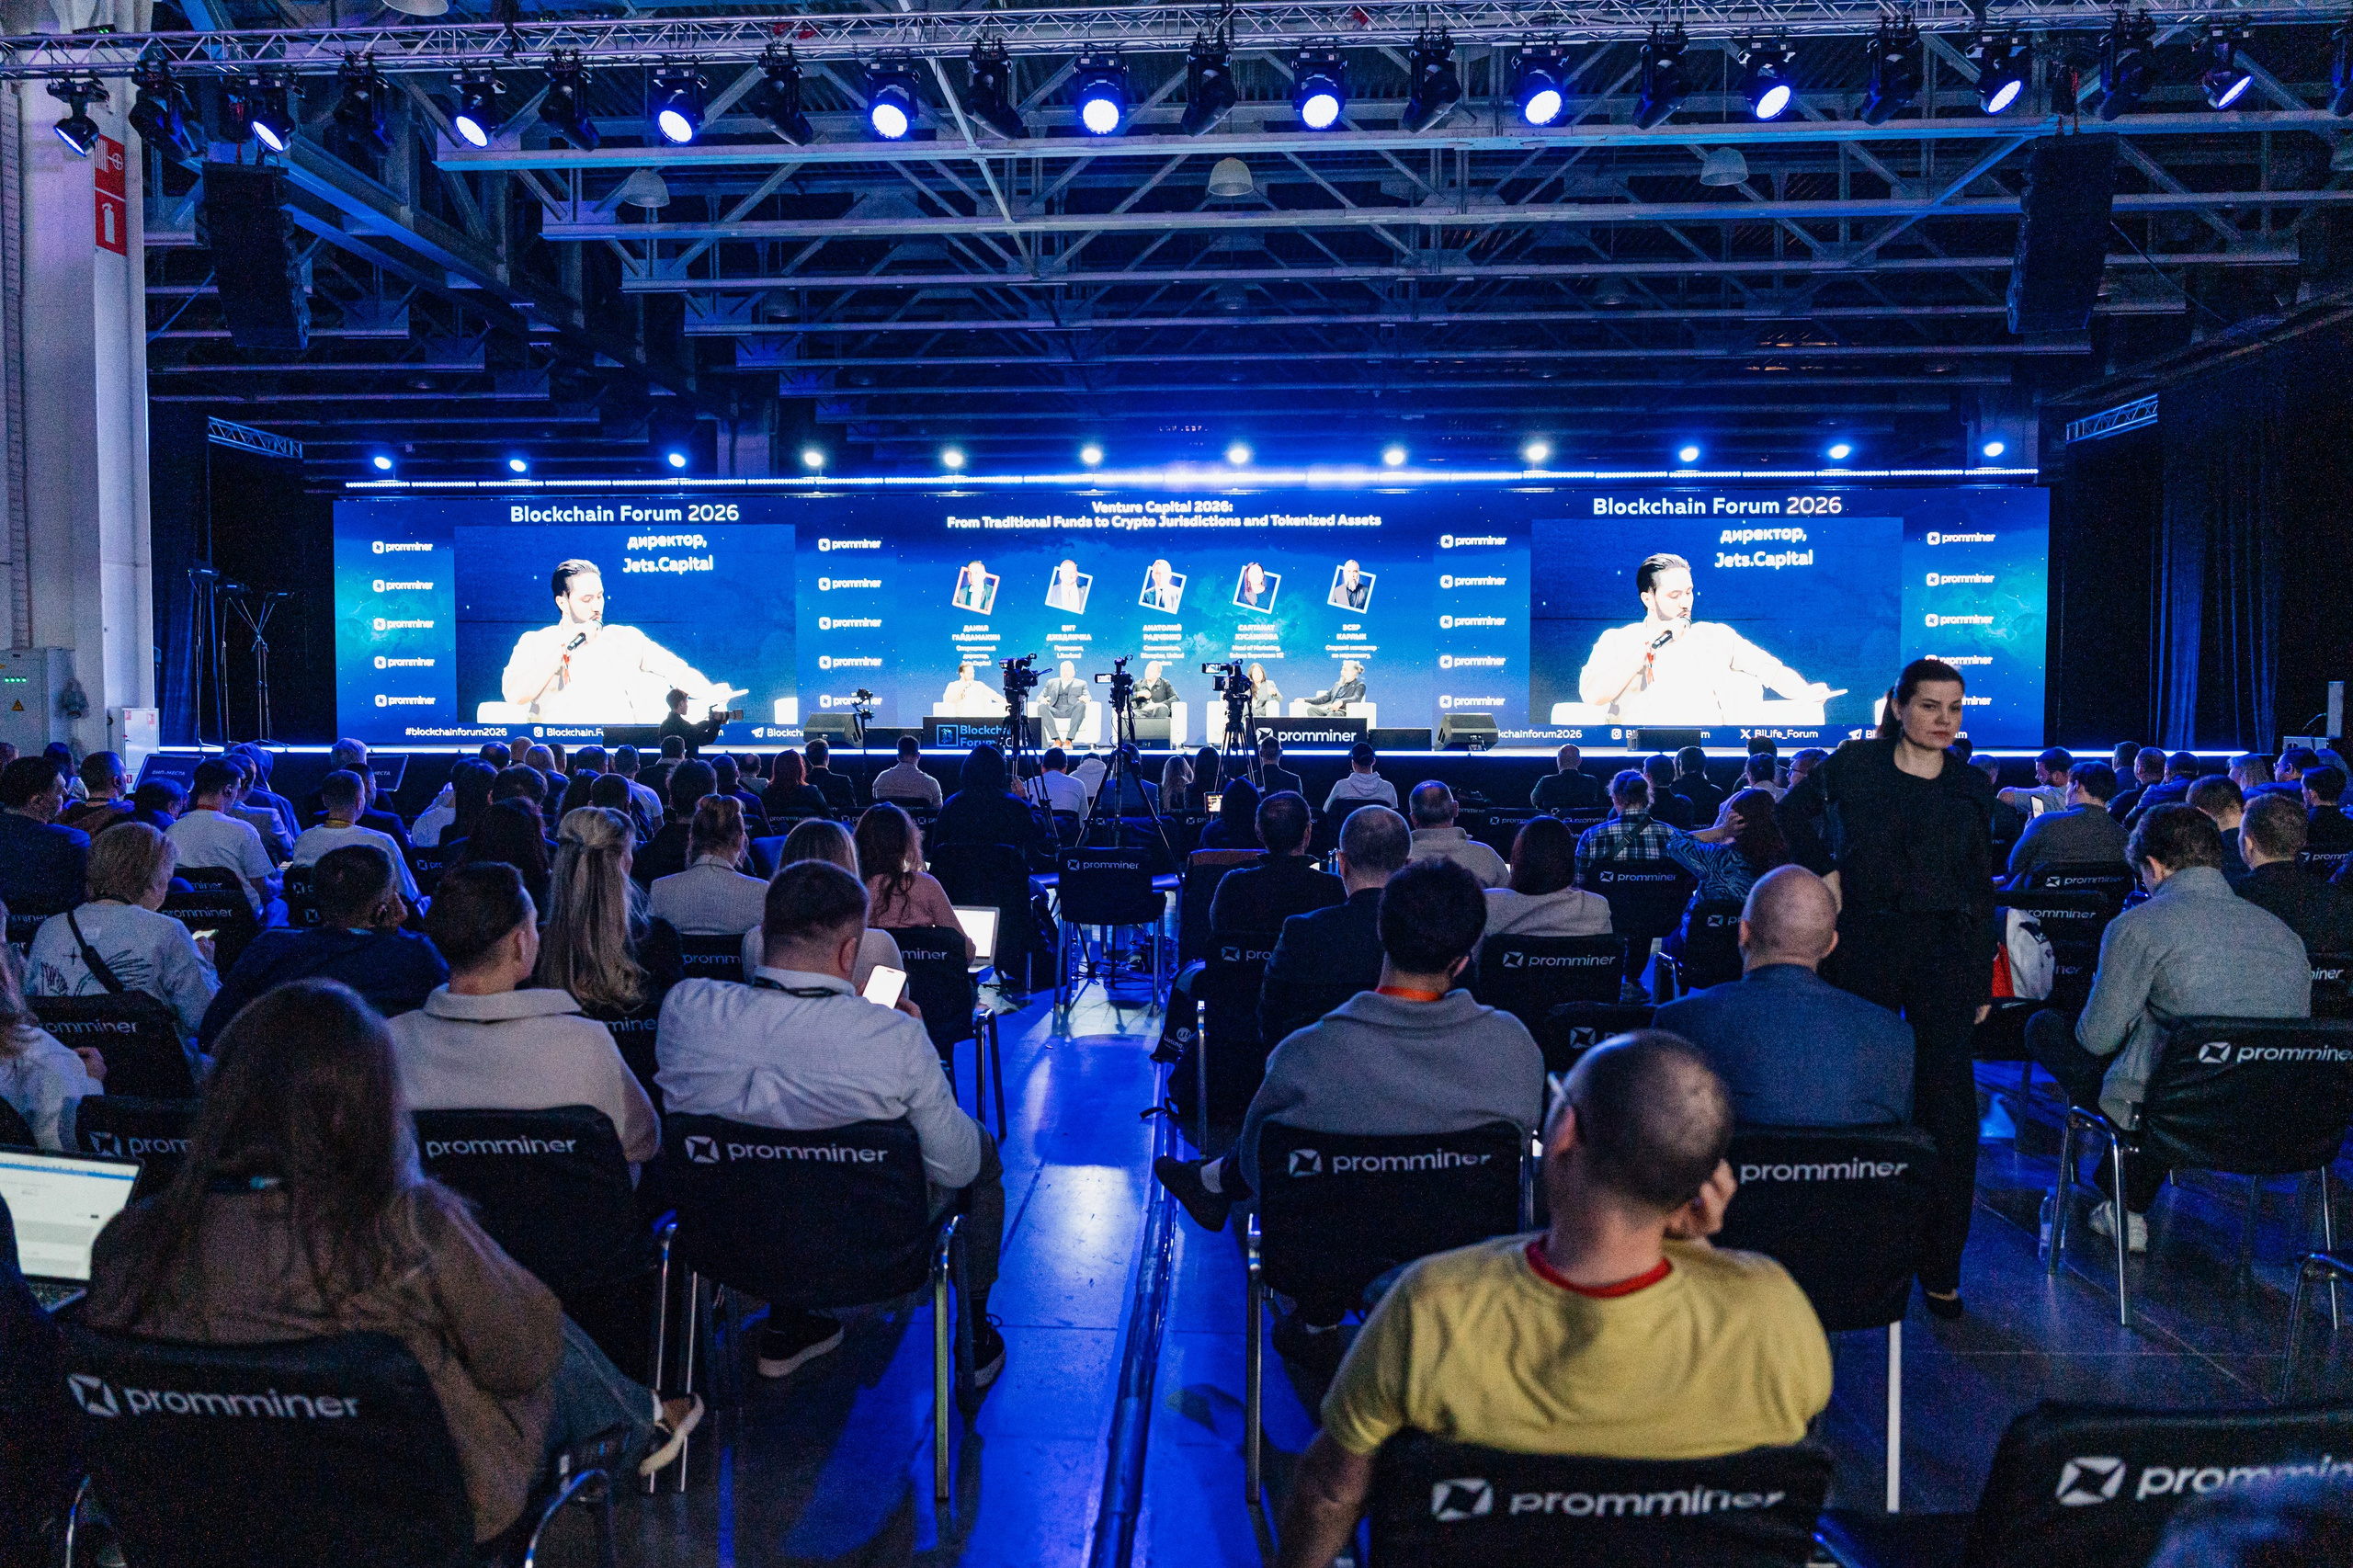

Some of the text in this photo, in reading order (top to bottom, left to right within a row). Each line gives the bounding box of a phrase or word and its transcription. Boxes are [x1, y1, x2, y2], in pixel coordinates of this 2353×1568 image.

[1092, 500, 1233, 515] Venture Capital 2026:
[1594, 496, 1841, 515] Blockchain Forum 2026
[511, 505, 739, 522] Blockchain Forum 2026
[948, 514, 1381, 529] From Traditional Funds to Crypto Jurisdictions and Tokenized Assets
[1455, 536, 1506, 546] promminer
[1721, 528, 1807, 544] директор,
[1942, 532, 1995, 543] promminer
[385, 542, 433, 552] promminer
[627, 534, 707, 551] директор,
[832, 540, 881, 550] promminer
[623, 554, 713, 574] Jets.Capital
[1715, 550, 1813, 570] Jets.Capital
[833, 578, 881, 589] promminer
[1455, 576, 1506, 587] promminer
[1941, 574, 1995, 585] promminer
[386, 581, 433, 591] promminer
[387, 619, 434, 630] promminer
[833, 618, 881, 629] promminer
[1454, 616, 1506, 627] promminer
[1940, 614, 1994, 625] promminer
[387, 657, 435, 668] promminer
[833, 656, 881, 667] promminer
[1454, 656, 1506, 667] promminer
[388, 695, 436, 706] promminer
[1454, 696, 1506, 707] promminer
[405, 727, 506, 737] #blockchainforum2026
[1279, 729, 1357, 744] promminer
[1498, 729, 1582, 738] kchainforum2026
[1083, 859, 1140, 871] promminer
[1617, 871, 1677, 882] promminer
[2029, 906, 2097, 919] romminer
[682, 953, 742, 966] promm
[902, 948, 948, 961] miner
[1528, 952, 1616, 968] promminer
[2236, 1044, 2353, 1064] prommine
[426, 1135, 577, 1158] promminer
[727, 1141, 889, 1164] promminer
[1333, 1149, 1492, 1175] promminer
[1740, 1157, 1909, 1185] promminer
[124, 1387, 358, 1418] promminer
[1508, 1484, 1786, 1517] promminer
